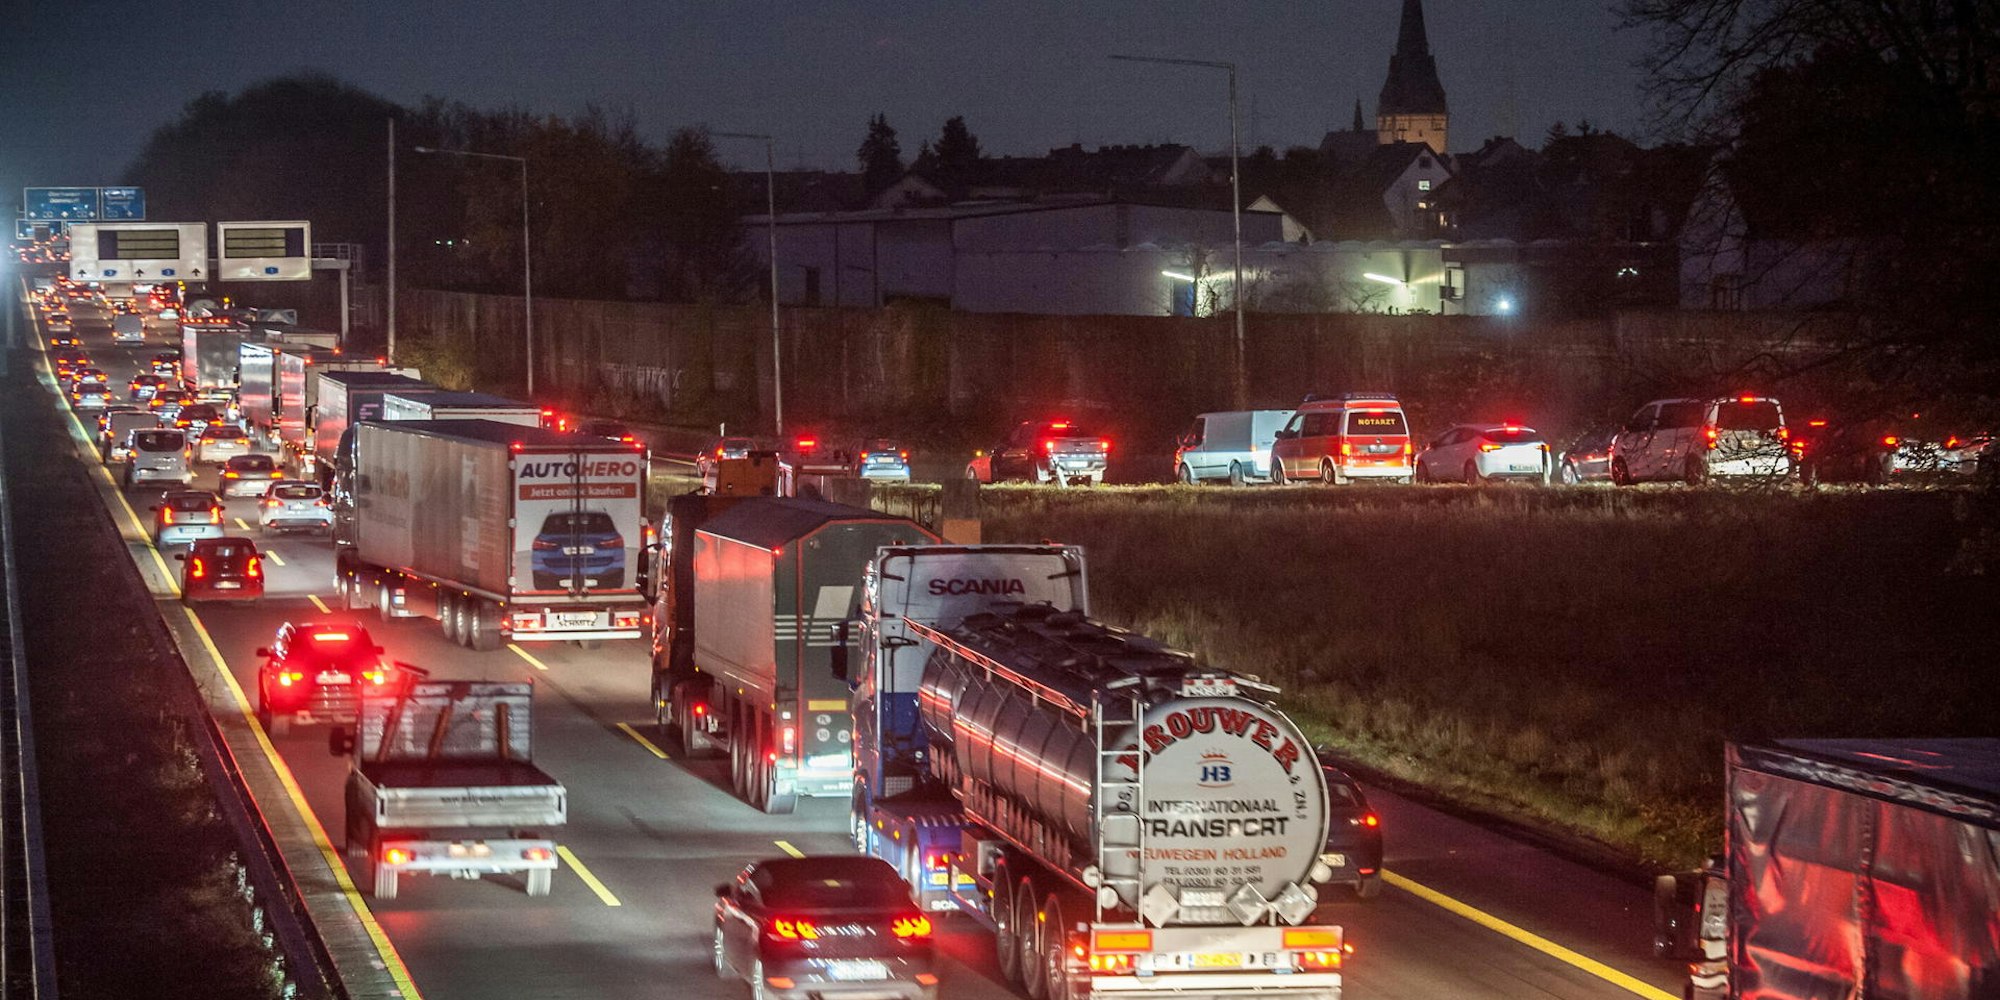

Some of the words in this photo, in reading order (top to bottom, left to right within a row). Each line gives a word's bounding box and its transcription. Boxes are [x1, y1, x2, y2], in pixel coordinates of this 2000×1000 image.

[520, 462, 637, 478] AUTOHERO
[531, 488, 554, 497] Jetzt
[589, 485, 625, 496] kaufen!
[929, 579, 1025, 596] SCANIA
[1116, 707, 1301, 775] BROUWER
[1148, 799, 1280, 814] INTERNATIONAAL
[1143, 817, 1290, 838] TRANSPORT
[1223, 846, 1288, 860] HOLLAND
